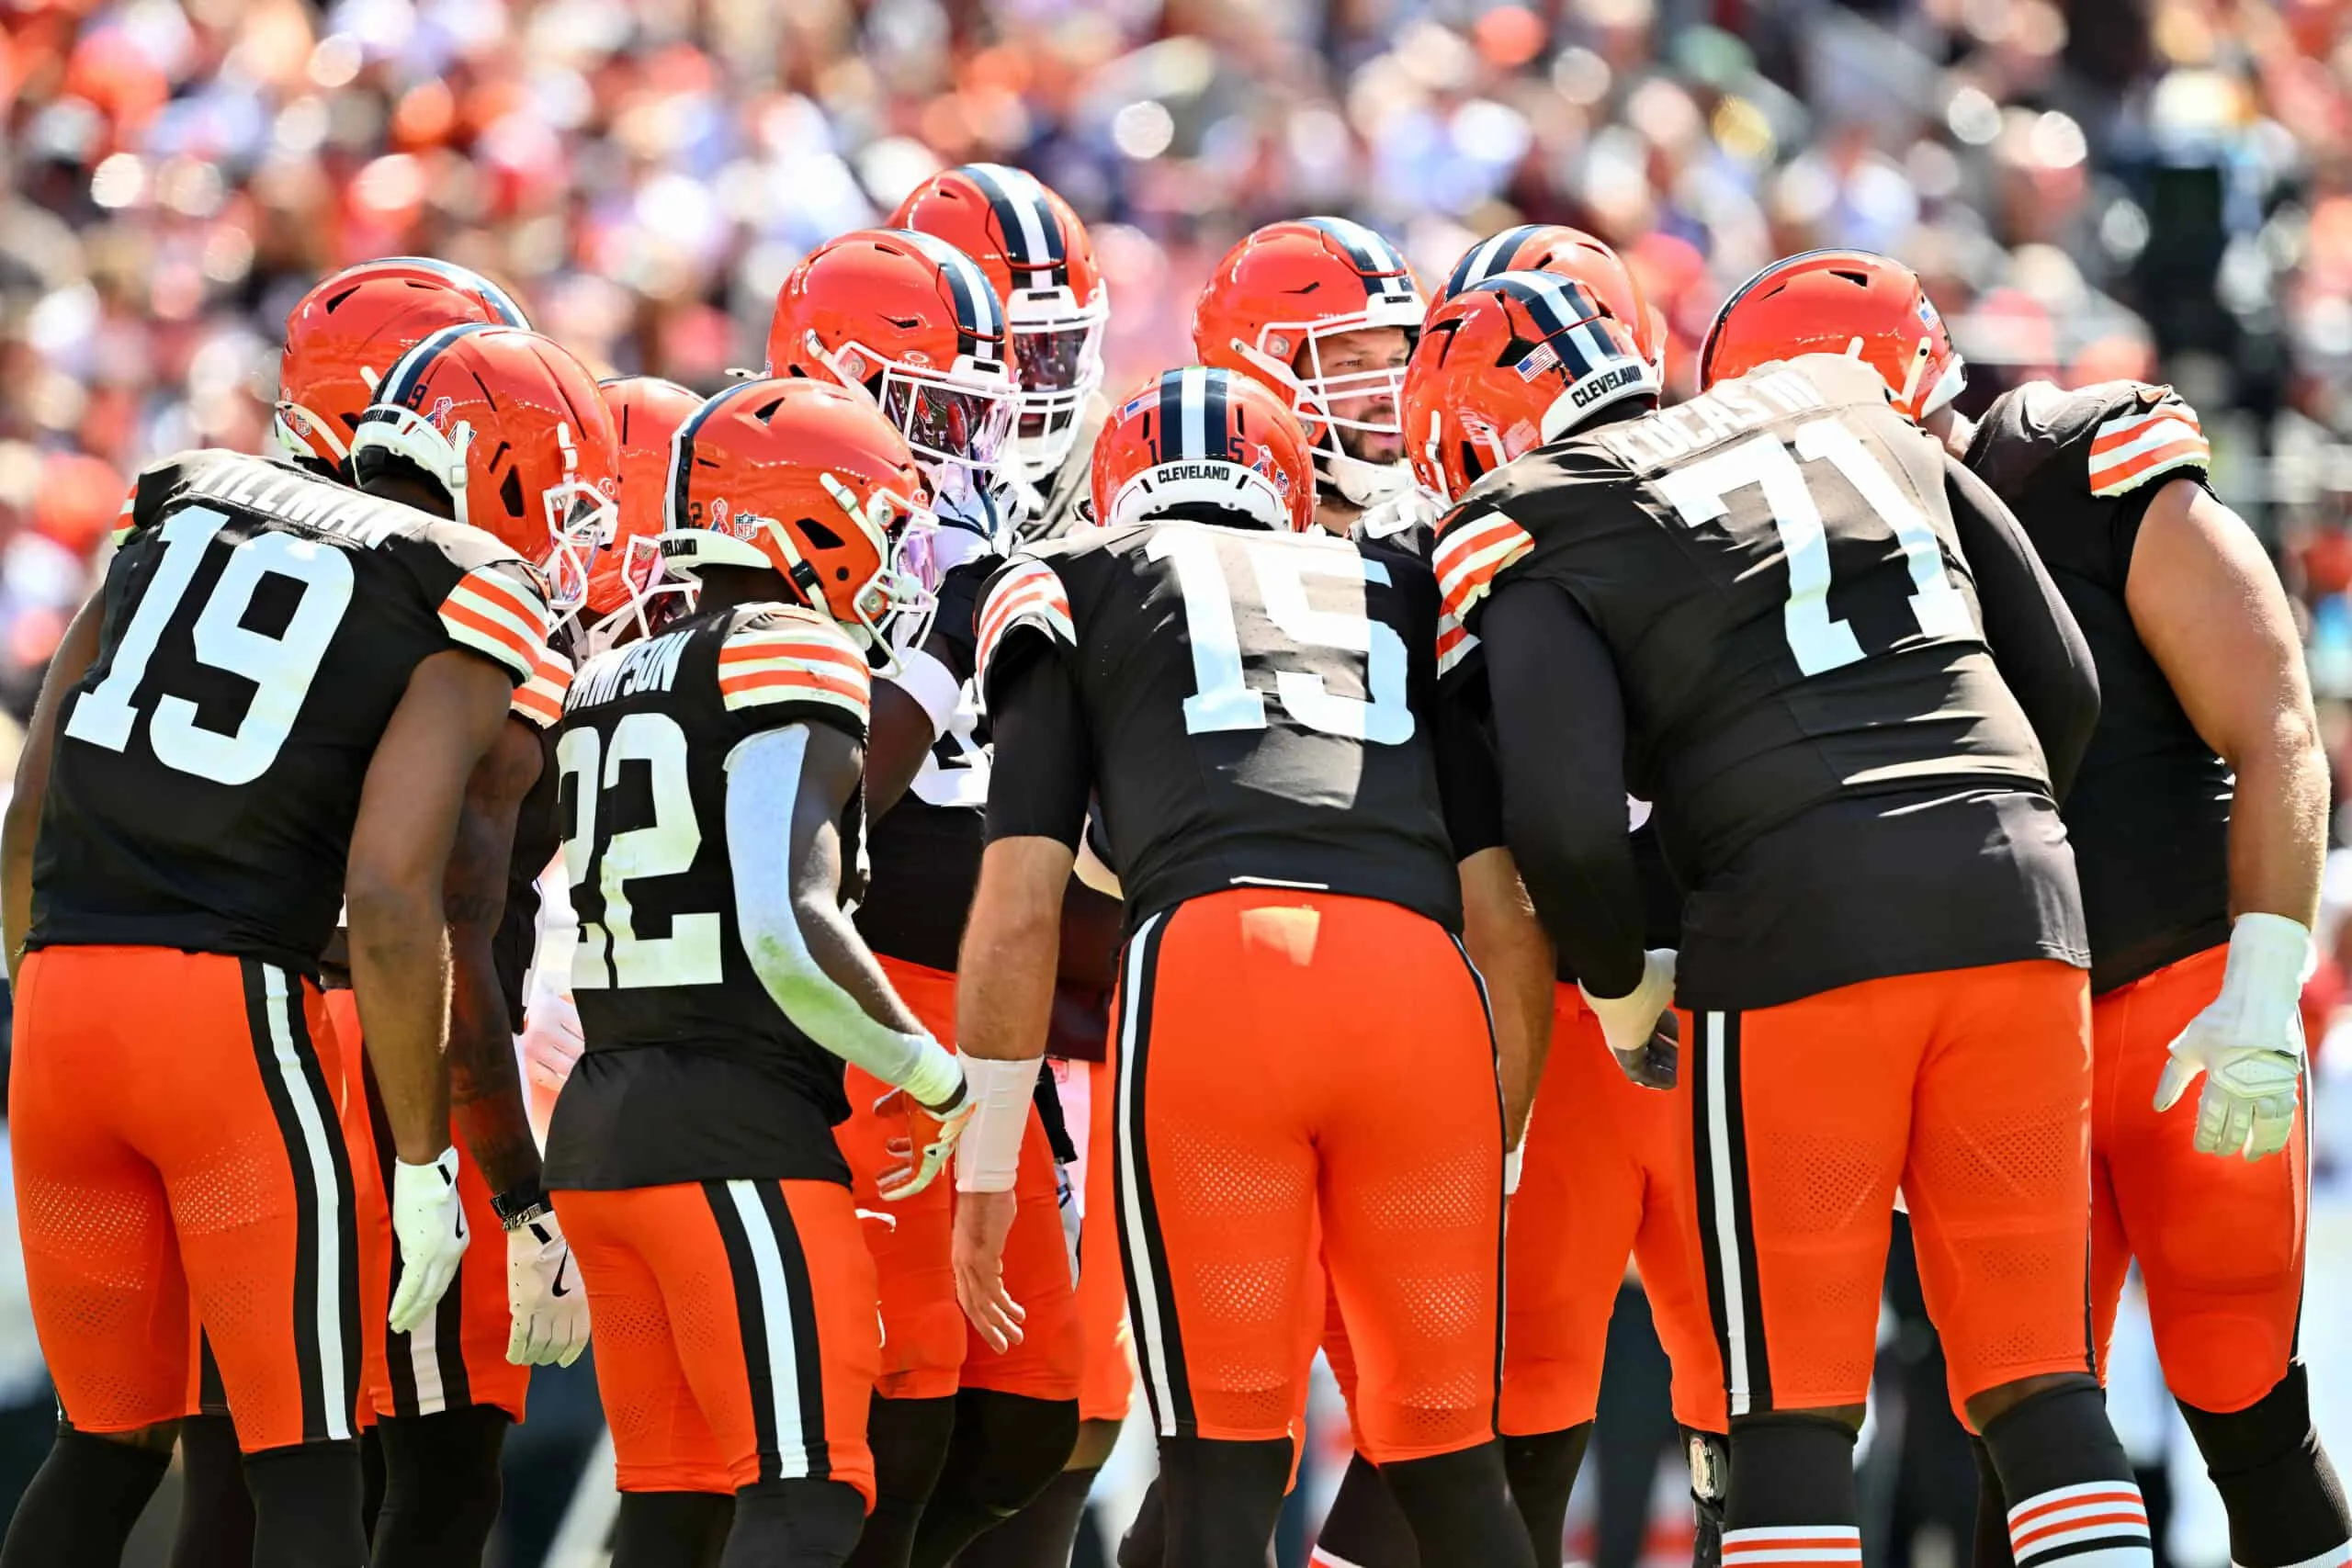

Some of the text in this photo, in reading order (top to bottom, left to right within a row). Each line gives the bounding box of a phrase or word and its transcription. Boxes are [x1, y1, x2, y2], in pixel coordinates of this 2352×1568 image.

[191, 459, 404, 549] TILLMAN
[1157, 465, 1229, 484] CLEVELAND
[1657, 419, 1978, 676] 71
[64, 504, 355, 785] 19
[1145, 527, 1416, 746] 15
[556, 713, 724, 989] 22
